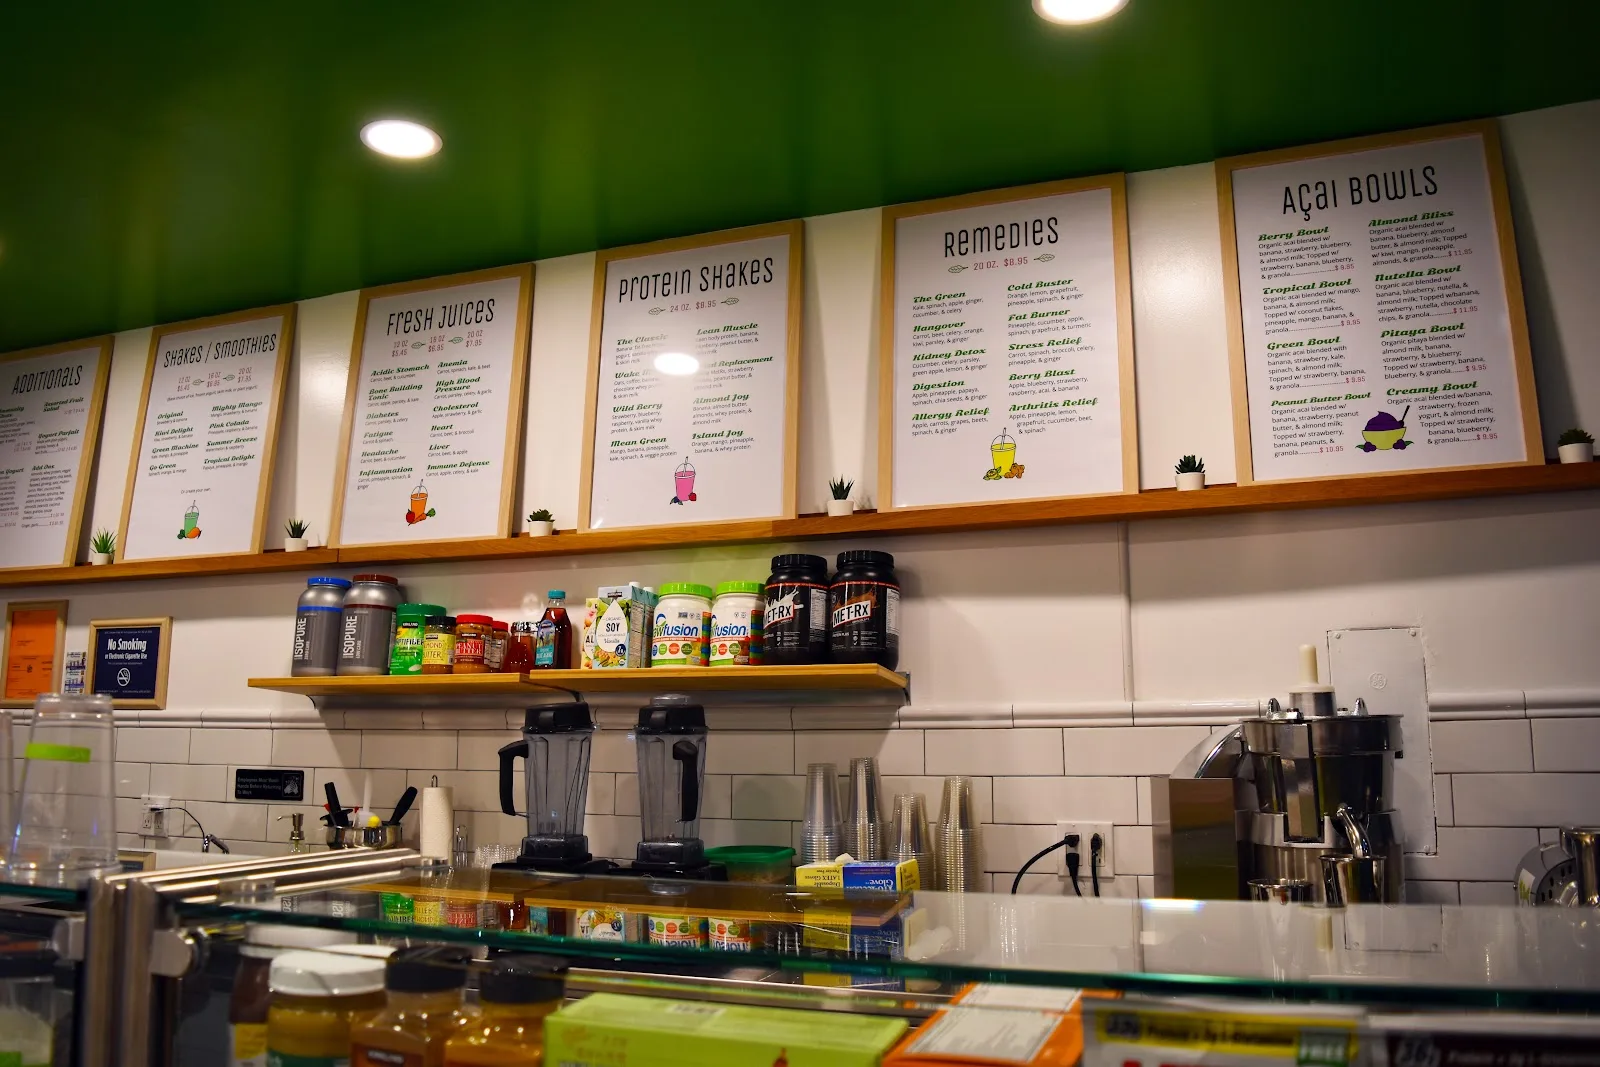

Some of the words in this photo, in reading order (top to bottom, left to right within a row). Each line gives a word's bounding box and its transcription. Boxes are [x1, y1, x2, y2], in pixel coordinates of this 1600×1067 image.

[1368, 215, 1418, 226] Almond
[1421, 211, 1454, 220] Bliss
[1258, 232, 1293, 241] Berry
[1296, 226, 1328, 236] Bowl
[1375, 270, 1423, 281] Nutella
[1427, 265, 1460, 275] Bowl
[1007, 282, 1032, 291] Cold
[1035, 279, 1073, 288] Buster
[1262, 282, 1315, 294] Tropical
[1318, 279, 1351, 288] Bowl
[934, 292, 965, 300] Green
[1030, 310, 1070, 318] Burner
[722, 323, 757, 332] Muscle
[913, 322, 965, 332] Hangover
[1380, 328, 1426, 337] Pitaya
[1430, 323, 1463, 332] Bowl
[1046, 337, 1081, 346] Relief
[1267, 342, 1303, 350] Green
[1307, 336, 1339, 345] Bowl
[913, 352, 951, 361] Kidney
[396, 364, 429, 373] Stomach
[1044, 369, 1074, 377] Blast
[912, 380, 964, 391] Digestion
[1386, 386, 1439, 395] Creamy
[1442, 381, 1476, 390] Bowl
[433, 402, 478, 411] Cholesterol
[1009, 402, 1058, 411] Arthritis
[955, 408, 989, 416] Relief
[692, 431, 724, 439] Island
[606, 623, 620, 632] SOY
[294, 618, 306, 660] ISOPURE
[343, 616, 357, 658] ISOPURE
[108, 639, 116, 650] No
[118, 638, 147, 652] Smoking
